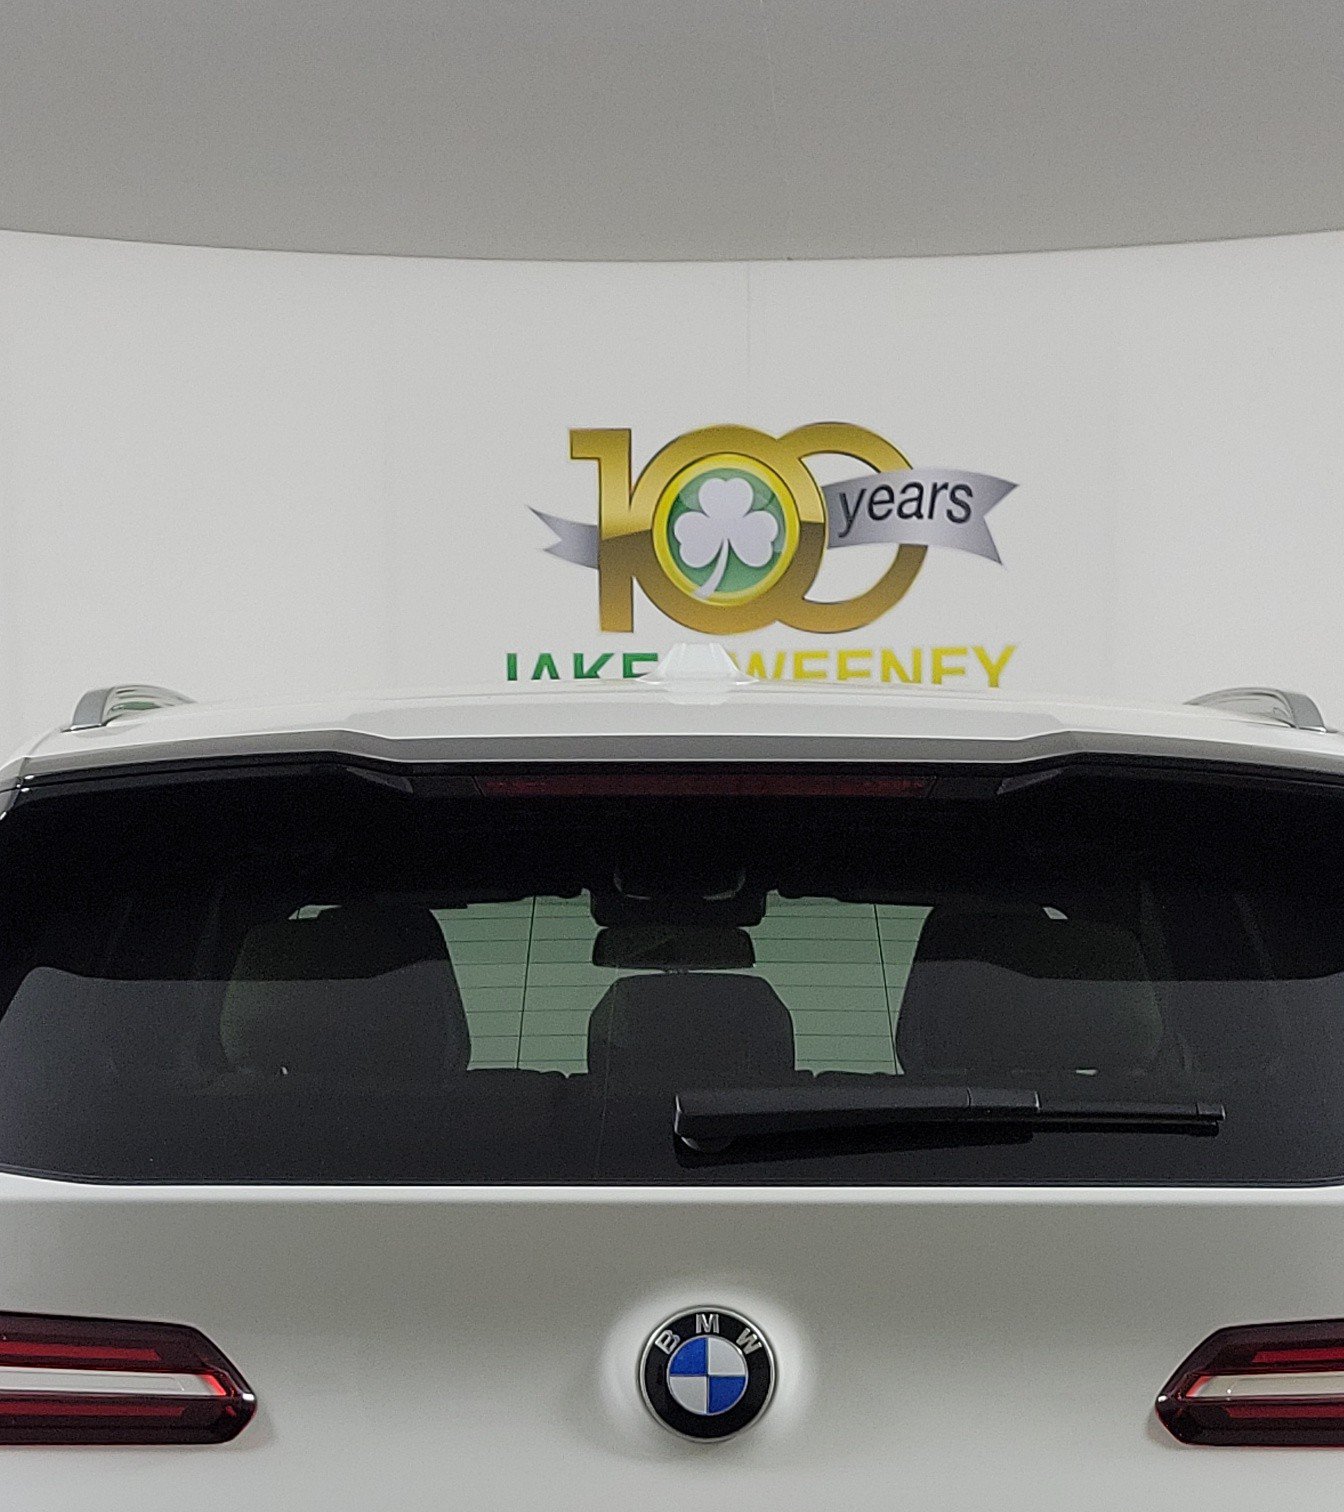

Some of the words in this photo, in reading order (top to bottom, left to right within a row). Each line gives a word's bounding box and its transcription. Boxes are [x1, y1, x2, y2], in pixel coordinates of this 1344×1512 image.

[569, 421, 930, 636] 100
[838, 476, 974, 538] years
[736, 645, 1016, 687] WEENEY
[654, 1313, 763, 1356] BMW
